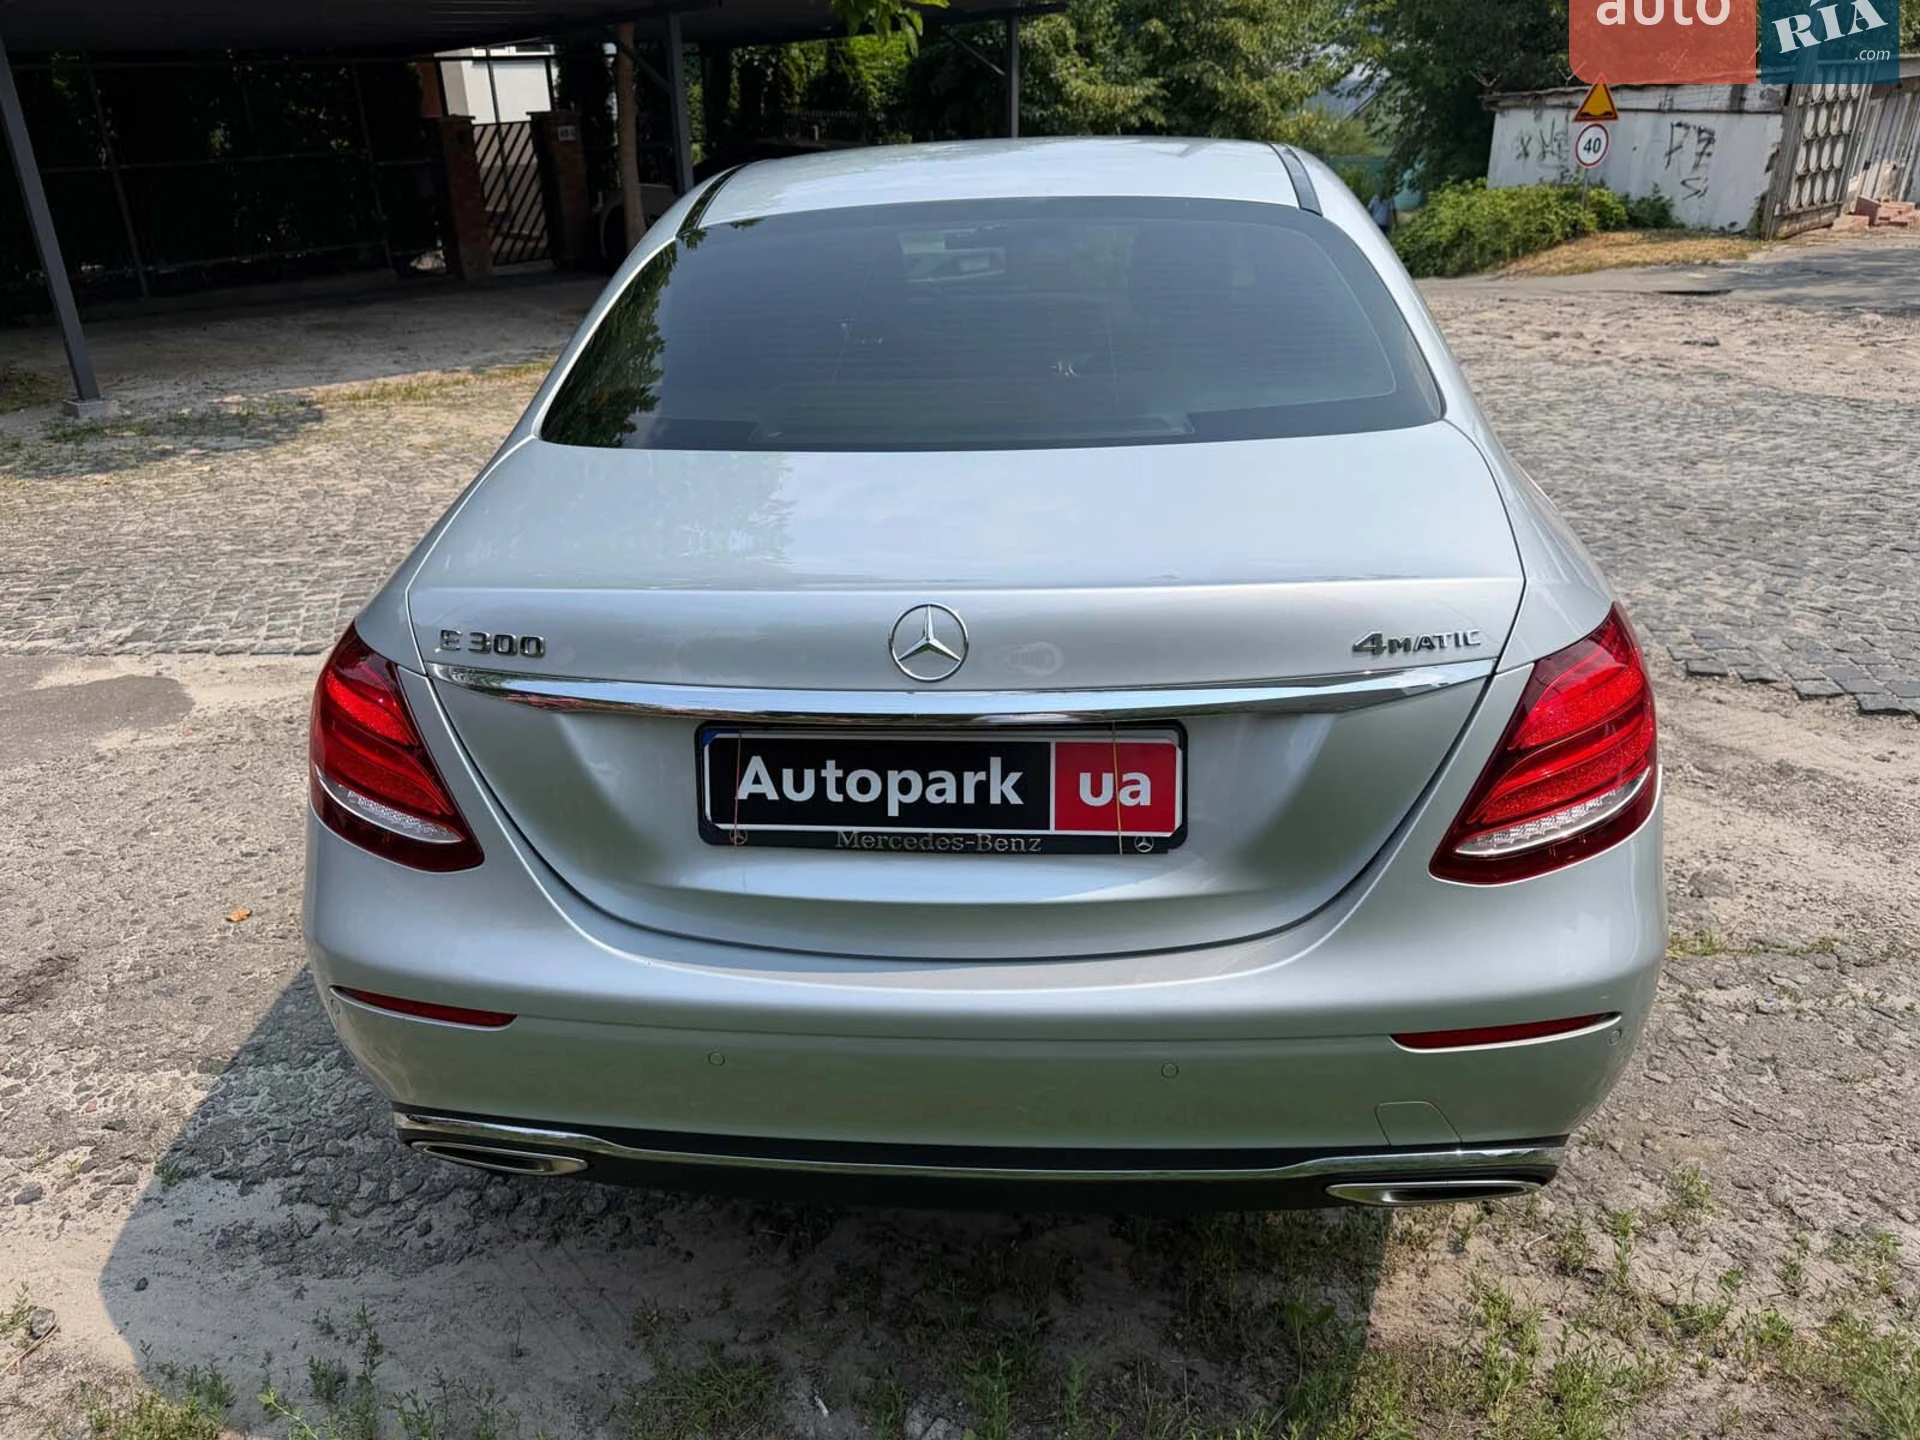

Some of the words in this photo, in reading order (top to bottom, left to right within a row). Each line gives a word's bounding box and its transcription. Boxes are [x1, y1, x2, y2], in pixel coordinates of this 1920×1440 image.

[1583, 137, 1602, 154] 40
[440, 629, 463, 651] E
[468, 631, 546, 658] 300
[1352, 629, 1482, 655] 4MATIC
[737, 755, 1024, 817] Autopark
[1079, 772, 1152, 807] ua
[834, 831, 1042, 852] Mercedes-Benz
